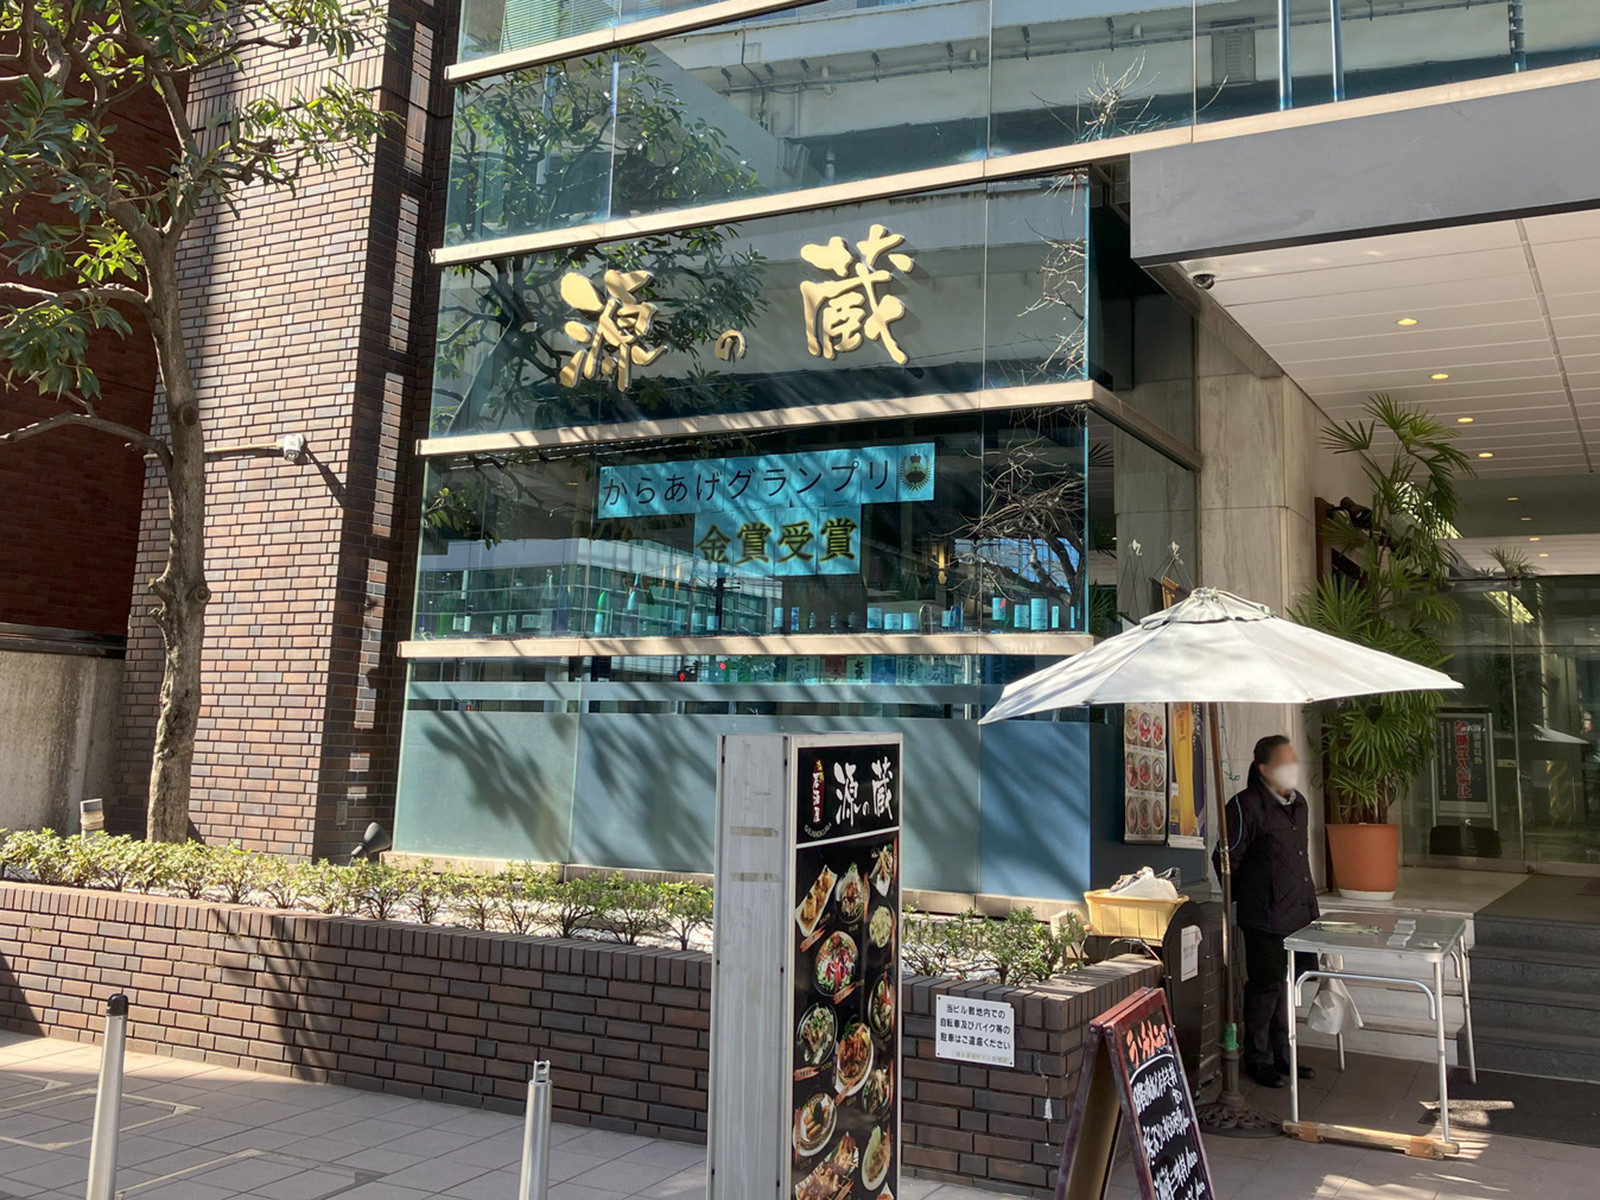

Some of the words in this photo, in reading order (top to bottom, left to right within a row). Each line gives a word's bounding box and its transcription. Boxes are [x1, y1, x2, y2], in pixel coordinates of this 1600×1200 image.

[559, 224, 914, 392] 源の蔵
[602, 460, 889, 505] からあげグランプリ
[696, 517, 859, 565] 金賞受賞
[833, 756, 894, 827] 源の蔵
[940, 1018, 1011, 1036] 自転車及びバイク等の
[946, 1003, 1006, 1020] 当ビル敷地内での
[940, 1032, 1011, 1050] 駐車はご遠慮ください
